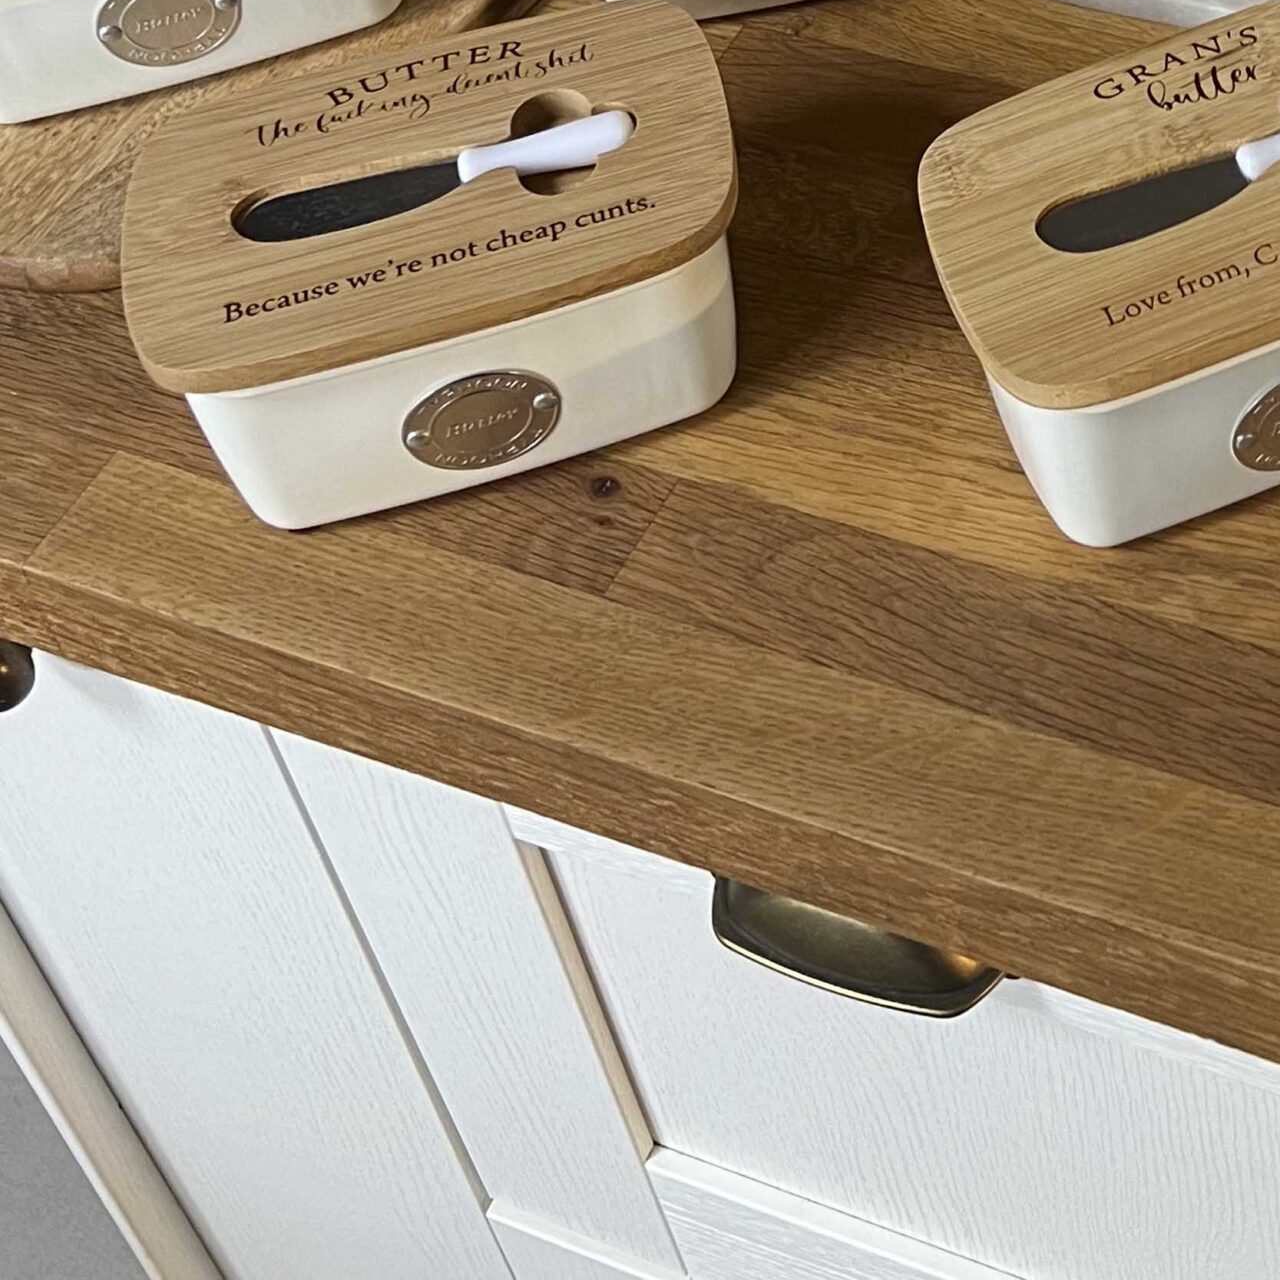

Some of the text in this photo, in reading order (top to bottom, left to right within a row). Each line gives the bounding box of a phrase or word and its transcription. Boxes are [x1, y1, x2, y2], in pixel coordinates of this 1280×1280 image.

[325, 40, 524, 107] BUTTER
[1092, 26, 1259, 101] GRAN'S
[1147, 60, 1261, 112] butter
[222, 195, 657, 324] Because we're not cheap cunts.
[1099, 290, 1172, 327] Love
[1176, 263, 1251, 299] from,
